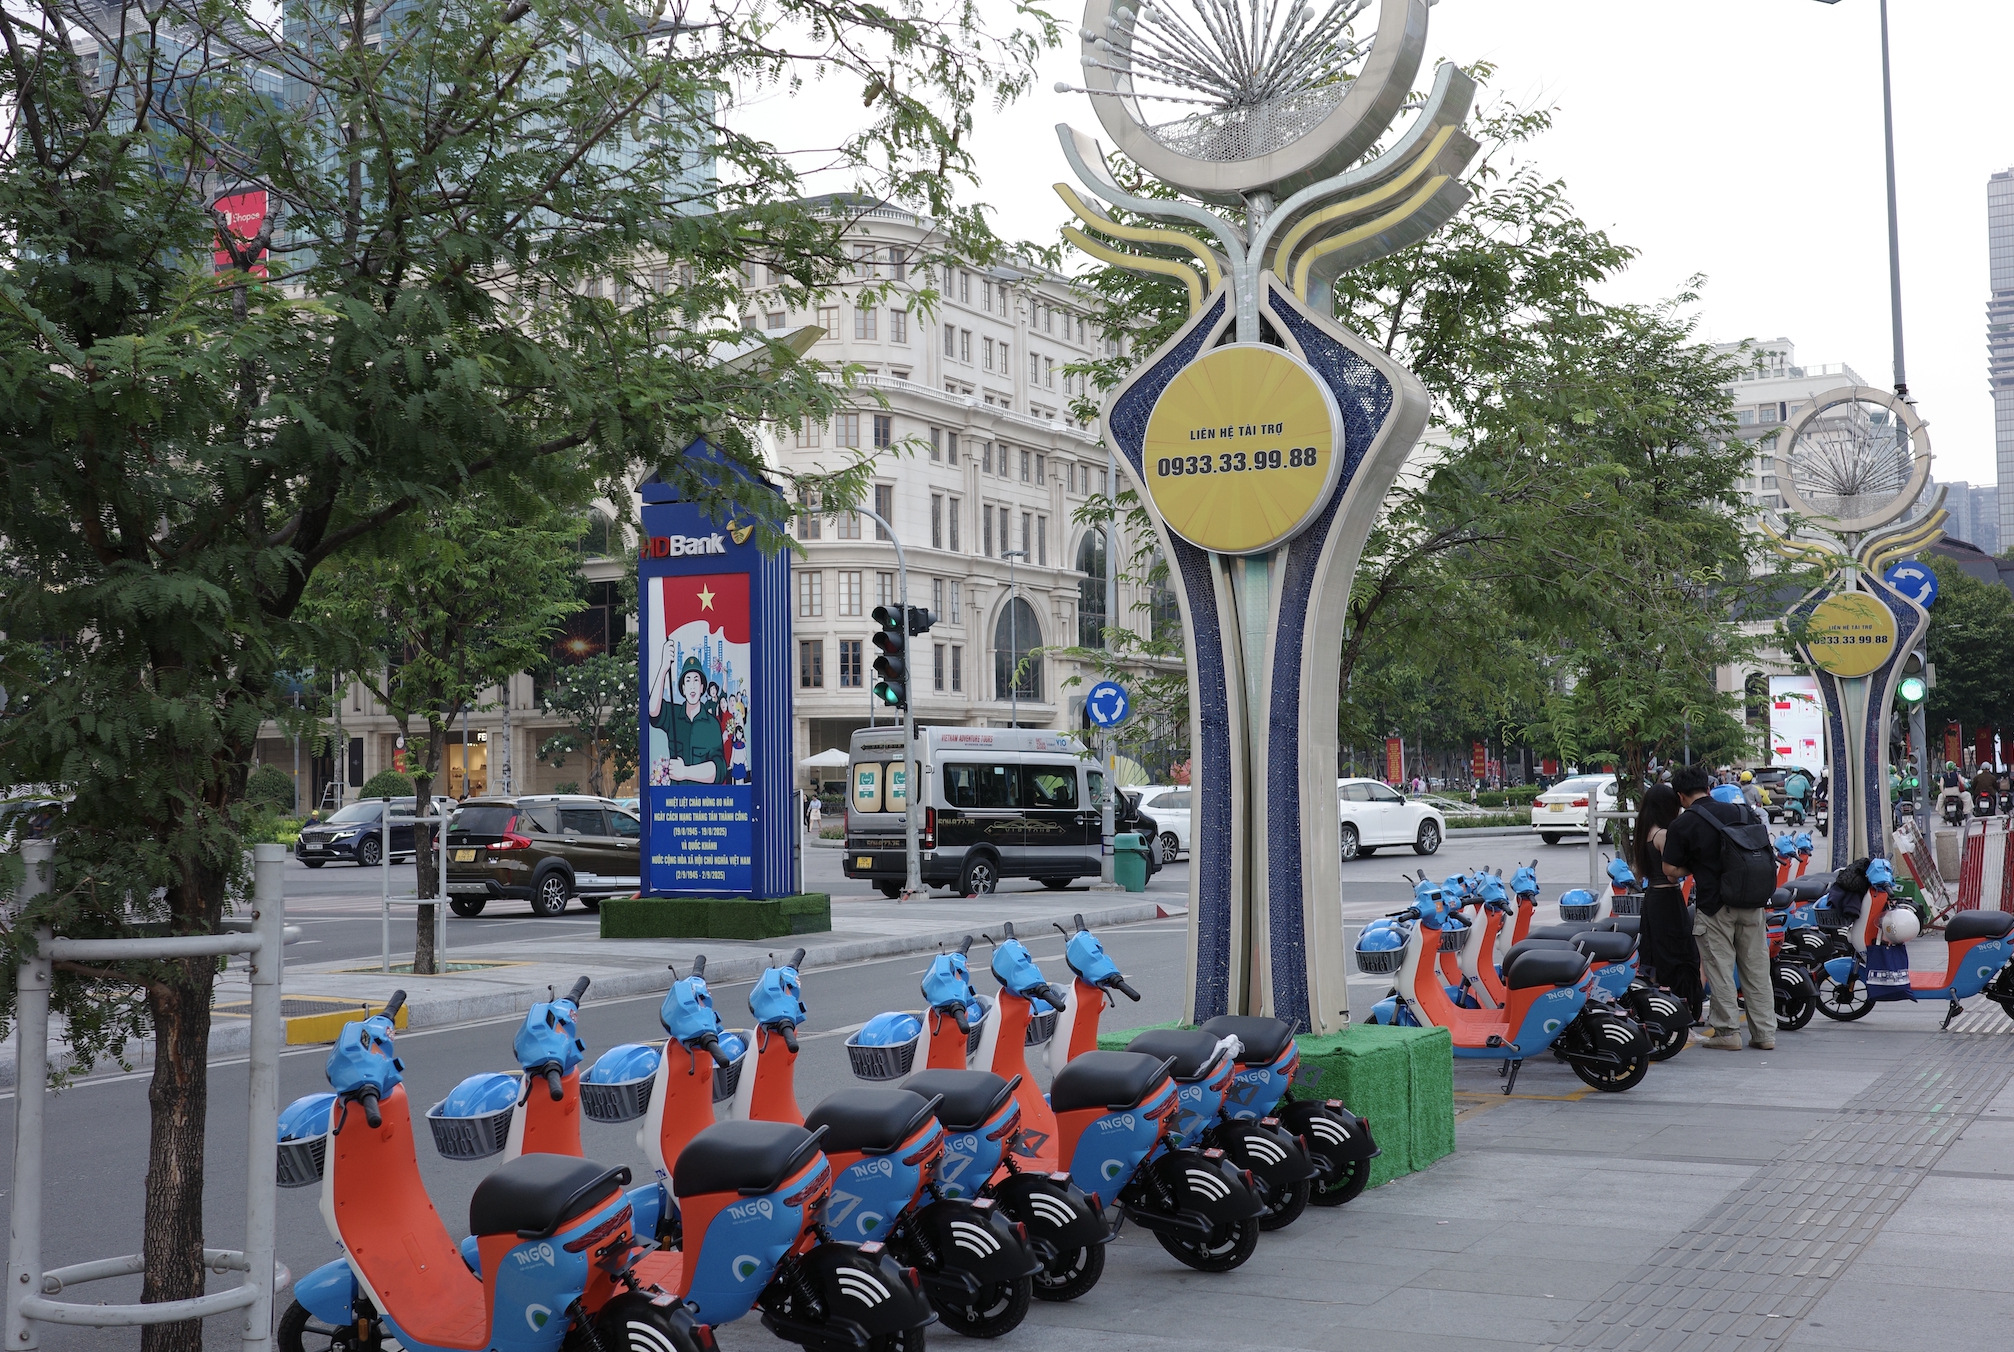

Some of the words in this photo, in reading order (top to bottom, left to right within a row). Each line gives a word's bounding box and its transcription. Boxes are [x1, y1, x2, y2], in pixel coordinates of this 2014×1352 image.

[233, 212, 260, 223] Shopee
[1190, 427, 1216, 441] LIÊN
[1220, 424, 1234, 440] HỆ
[1238, 423, 1256, 437] TÀI
[1260, 422, 1284, 436] TRỢ
[1157, 447, 1318, 477] 0933.33.99.88
[941, 734, 958, 742] VIETNAM
[959, 734, 980, 743] ADVENTURE
[981, 735, 994, 743] TOURS
[666, 796, 678, 808] NHIỆT
[679, 796, 688, 808] LIỆT
[689, 796, 701, 807] CHÀO
[702, 796, 715, 807] MỪNG
[716, 798, 722, 807] 80
[723, 796, 734, 807] NĂM
[654, 810, 665, 821] NGÀY
[666, 810, 678, 821] CÁCH
[679, 812, 692, 823] MẠNG
[693, 810, 707, 821] THÁNG
[708, 810, 717, 821] TÁM
[718, 810, 734, 821] THÀNH
[734, 810, 748, 821] CÔNG
[673, 827, 698, 837] (19/8/1945
[701, 827, 728, 837] 19/8/2025)
[681, 839, 687, 850] VÀ
[688, 839, 701, 851] QUỐC
[701, 839, 718, 850] KHÁNH
[651, 853, 664, 865] NƯỚC
[664, 853, 676, 866] CỘNG
[677, 854, 687, 865] HÒA
[688, 854, 694, 865] XÃ
[694, 854, 703, 866] HỘI
[704, 854, 713, 865] CHỦ
[714, 854, 729, 865] NGHĨA
[729, 854, 739, 867] VIỆT
[740, 856, 751, 865] NAM
[676, 870, 698, 880] (2/9/1945
[702, 870, 726, 881] 2/9/2025)
